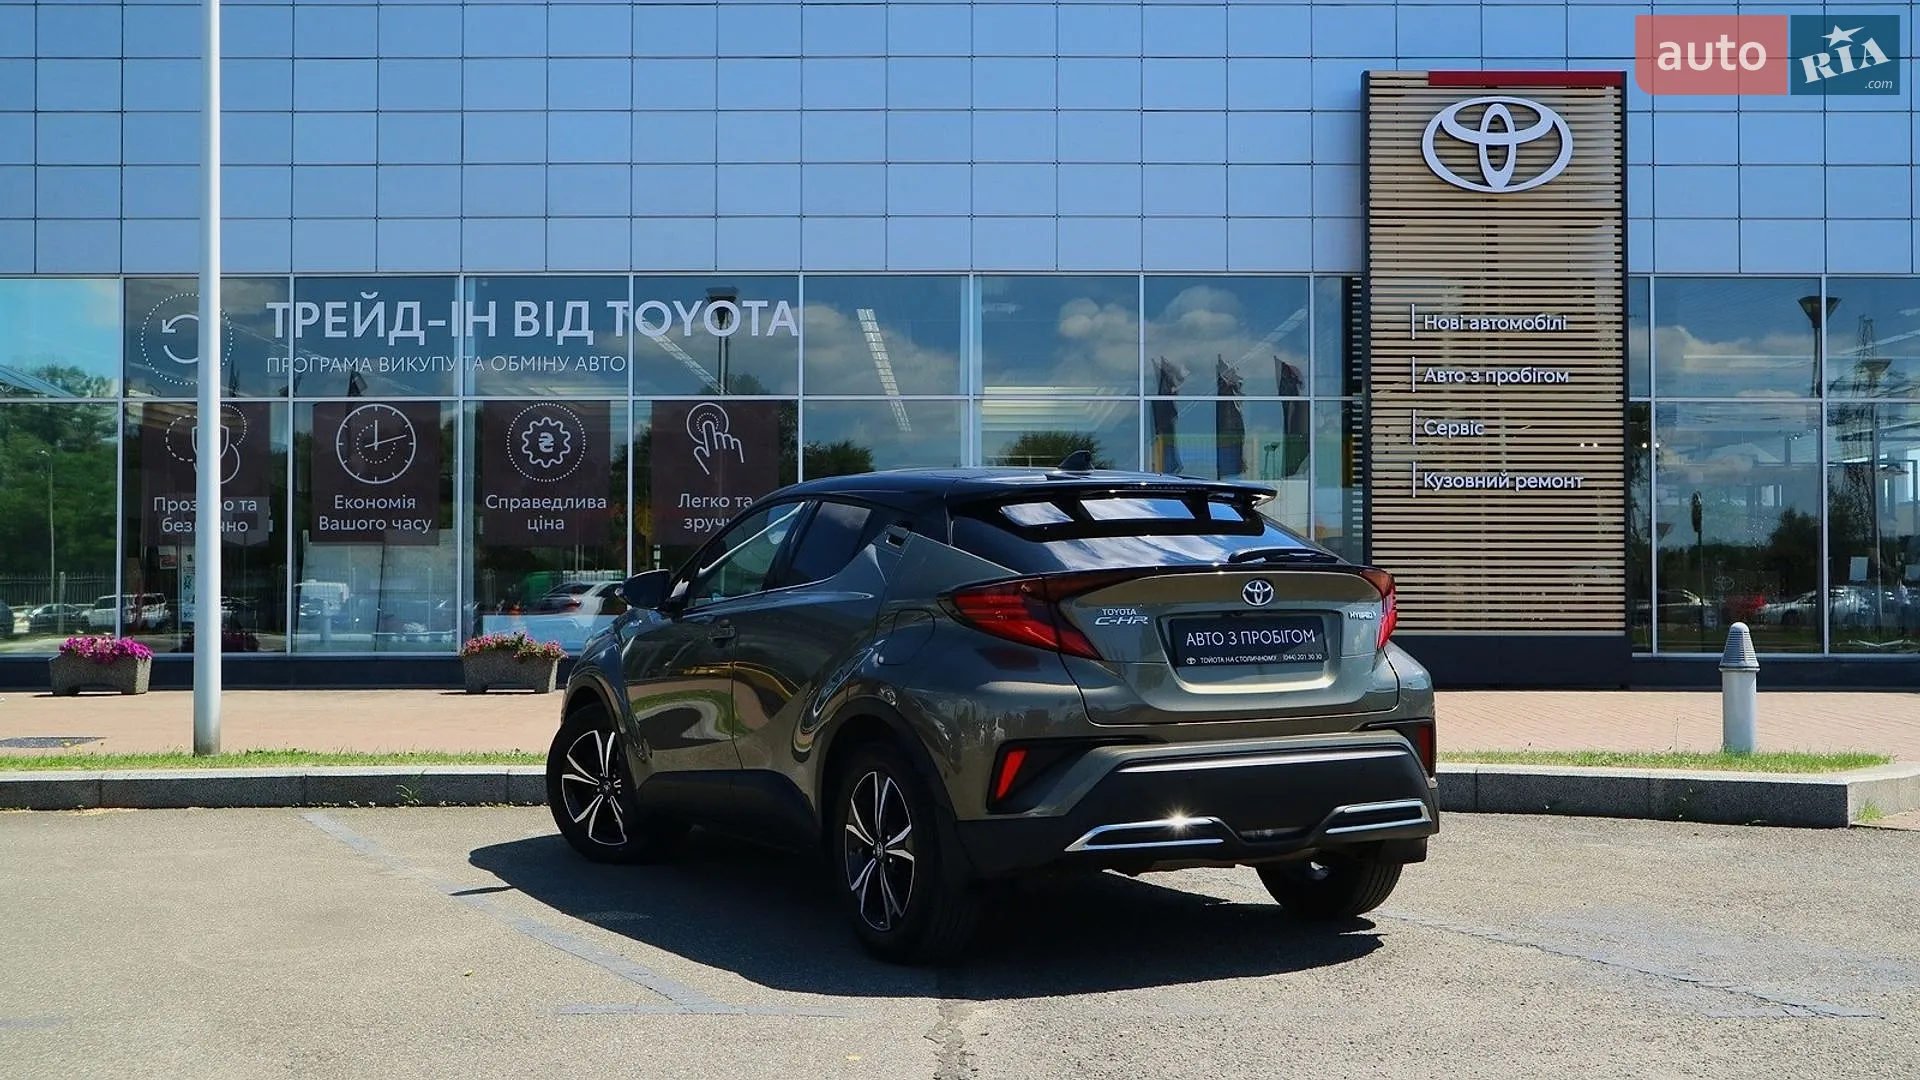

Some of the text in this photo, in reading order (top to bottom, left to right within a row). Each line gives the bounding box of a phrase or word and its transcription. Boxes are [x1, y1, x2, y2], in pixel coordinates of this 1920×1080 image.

[265, 291, 799, 346] ТРЕЙД-ІН ВІД TOYOTA
[1423, 314, 1567, 331] Нові автомобілі
[267, 356, 627, 373] ПРОГРАМА ВИКУПУ ТА ОБМІНУ АВТО
[1424, 366, 1570, 386] Авто з пробігом
[1424, 419, 1485, 439] Сервіс
[1424, 469, 1584, 492] Кузовний ремонт
[153, 496, 257, 515] Прозо та
[334, 494, 416, 510] Економія
[485, 494, 607, 512] Справедлива
[677, 493, 753, 509] Легко та
[318, 516, 432, 535] Вашого часу
[527, 515, 565, 532] ціна
[1095, 616, 1149, 626] C-HR
[1101, 608, 1137, 616] TOYOTA
[1186, 631, 1225, 647] АВТО
[1240, 628, 1316, 645] ПРОБІГОМ
